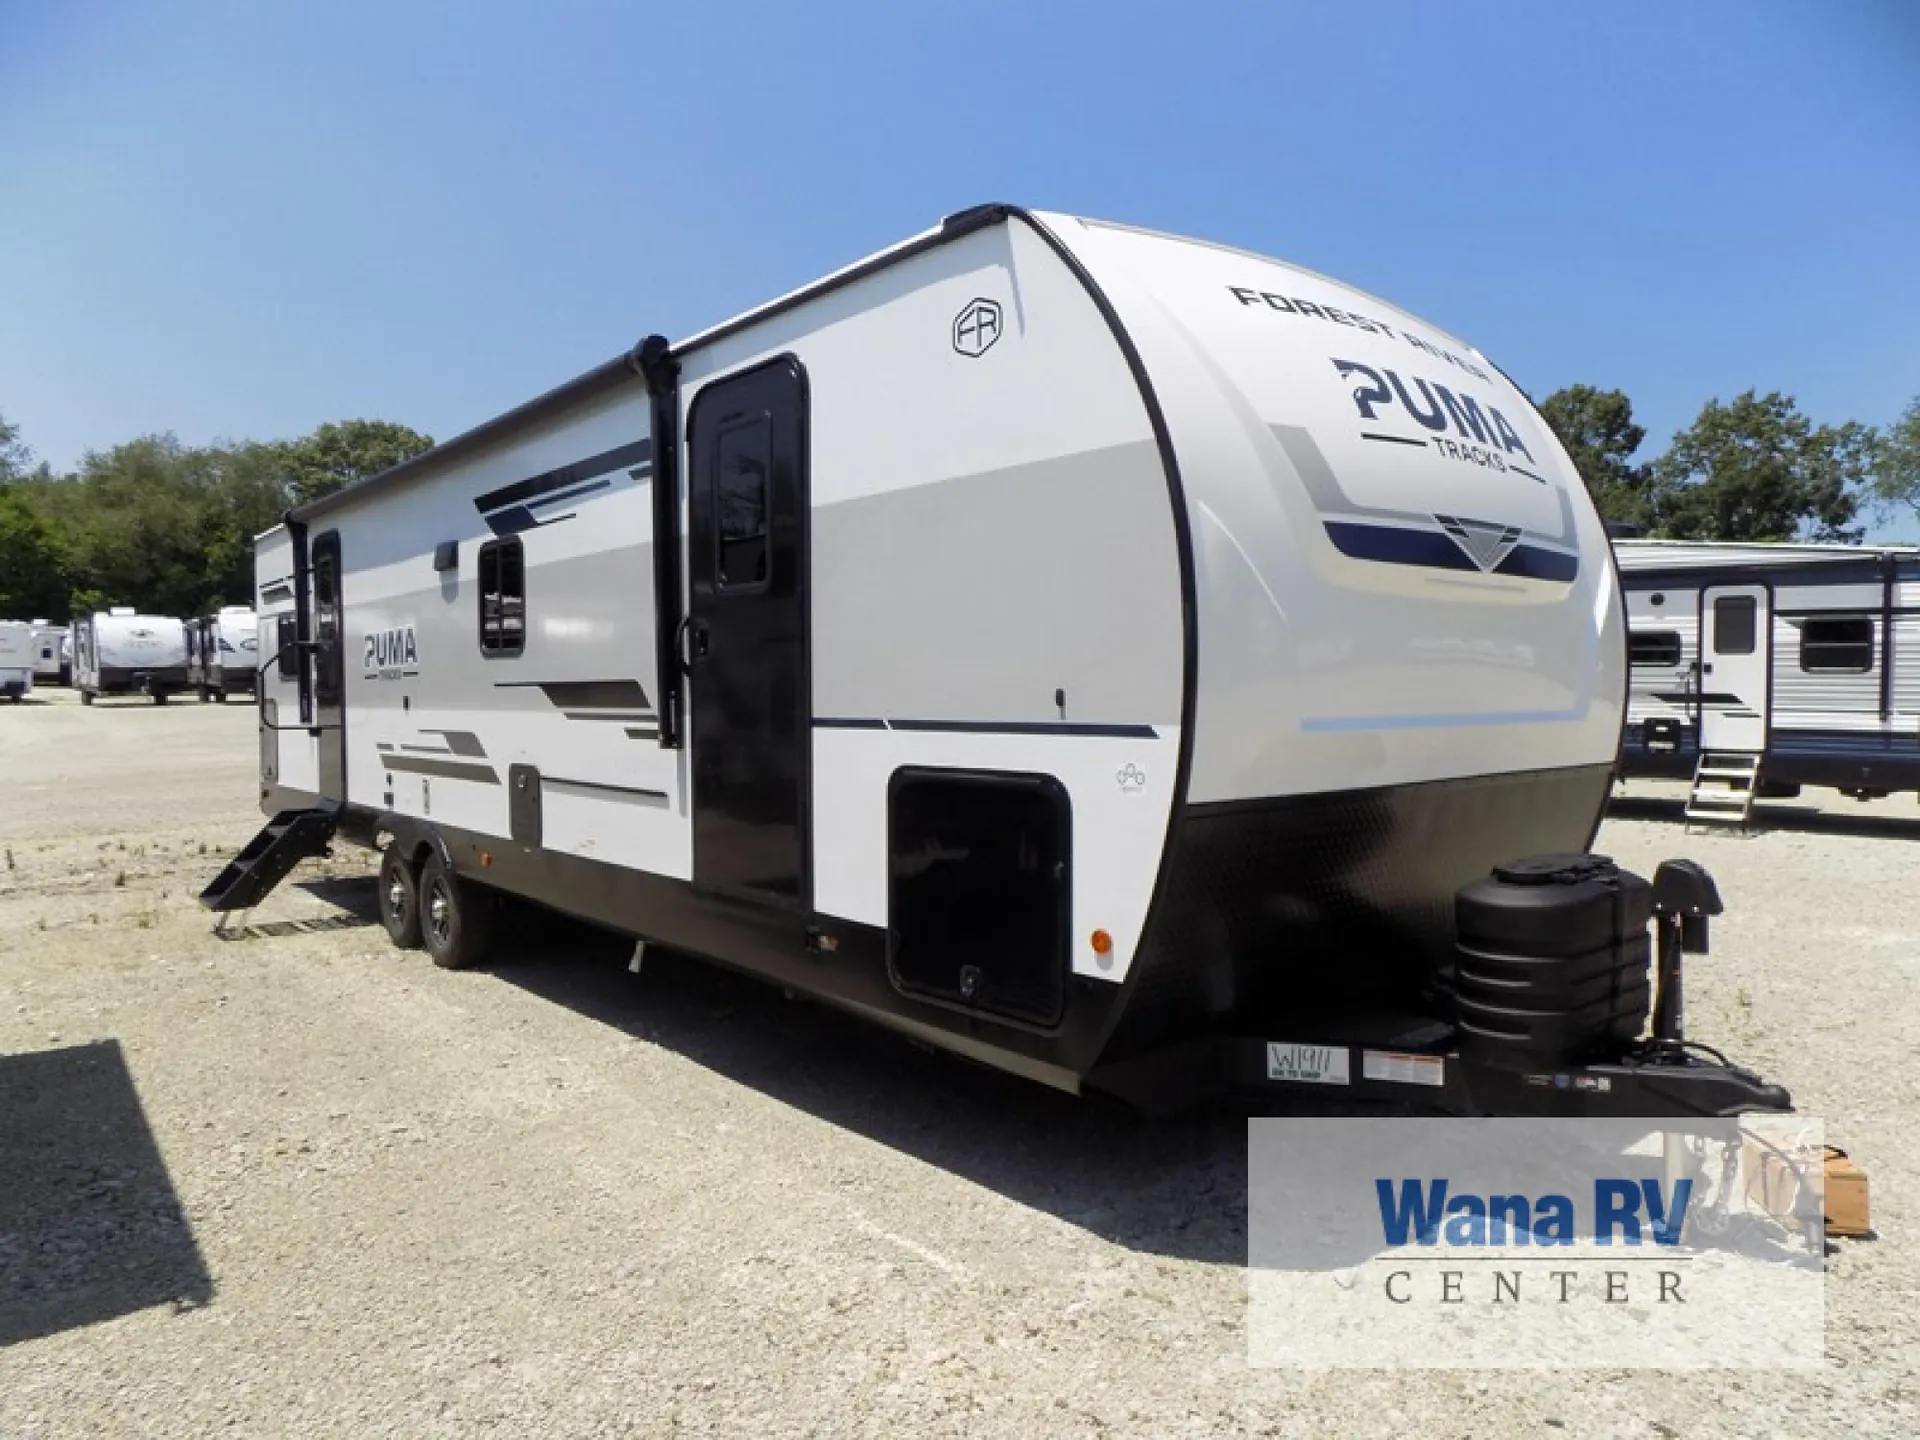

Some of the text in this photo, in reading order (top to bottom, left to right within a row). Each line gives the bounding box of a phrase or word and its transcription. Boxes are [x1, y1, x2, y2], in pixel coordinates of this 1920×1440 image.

[1228, 285, 1395, 338] FOREST
[1330, 357, 1536, 465] PUMA
[1431, 436, 1507, 473] TRACKS
[364, 628, 418, 668] PUMA
